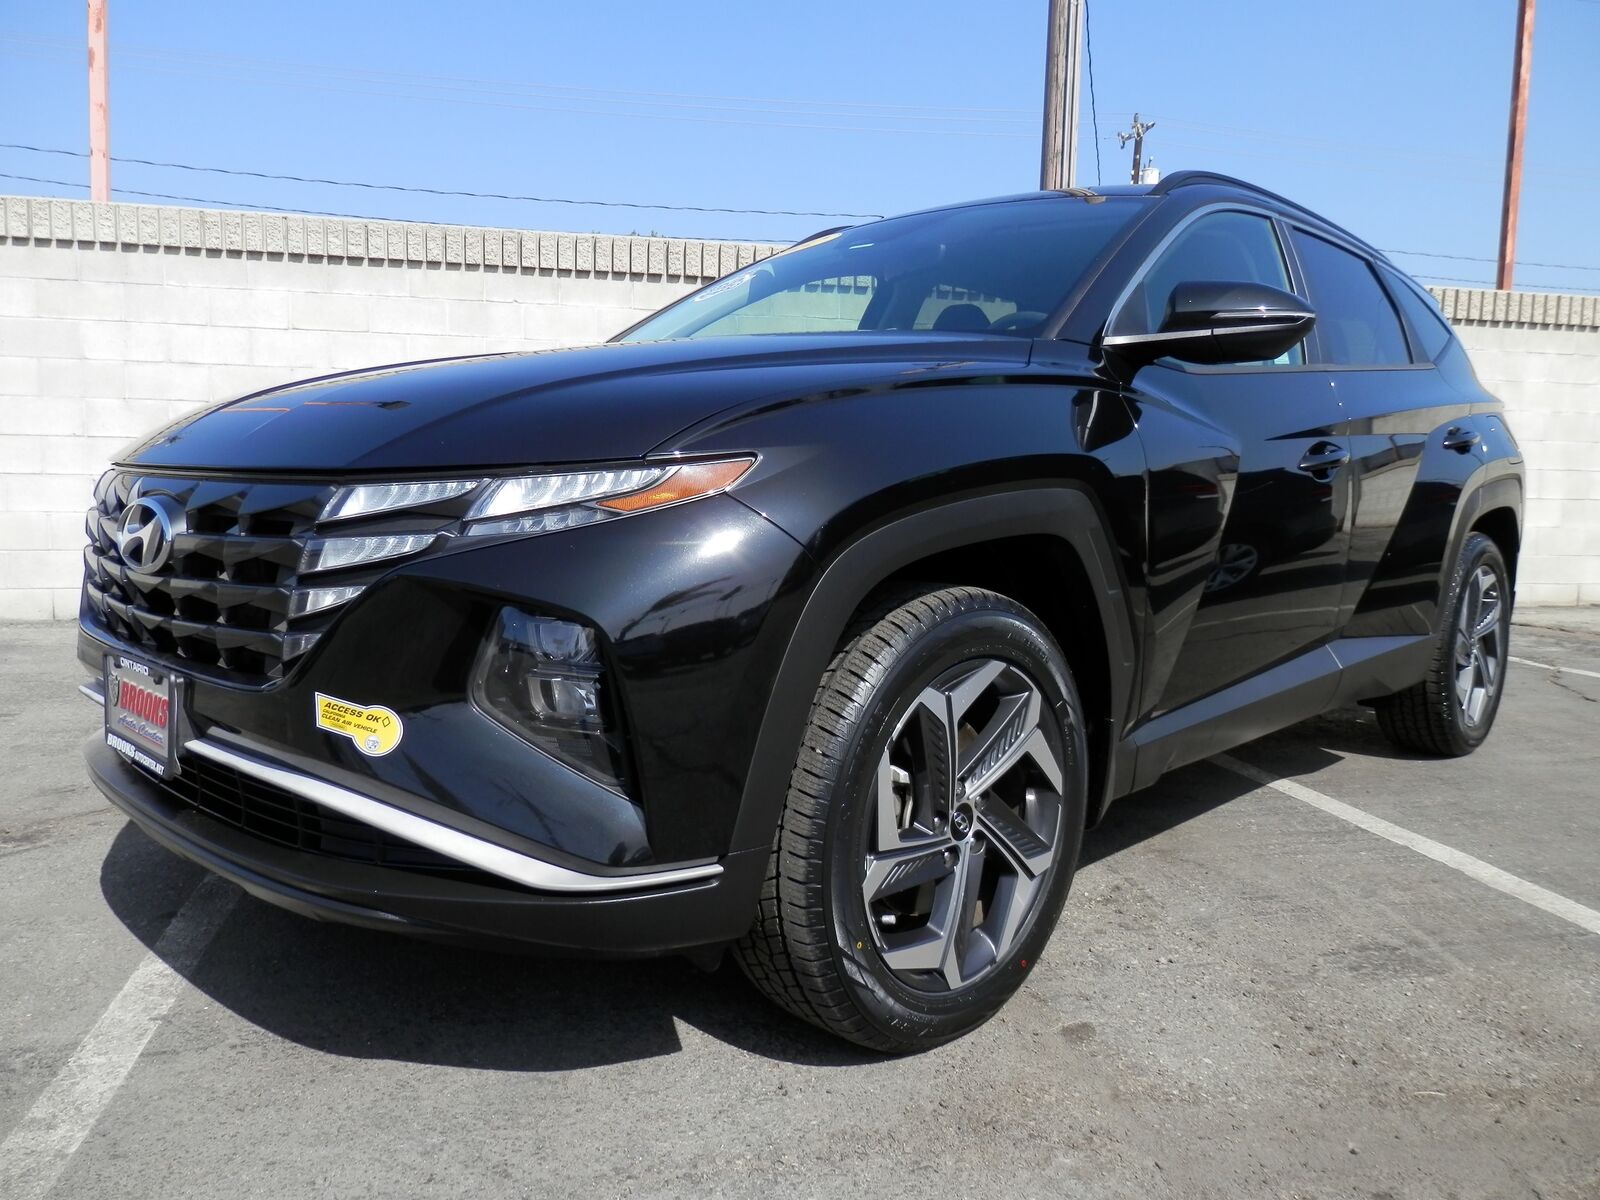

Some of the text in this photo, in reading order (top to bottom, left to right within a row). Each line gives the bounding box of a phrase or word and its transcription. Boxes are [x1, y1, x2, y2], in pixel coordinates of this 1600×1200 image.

[120, 657, 149, 676] ONTARIO
[120, 680, 169, 729] BROOKS
[324, 702, 382, 723] ACCESS OK
[321, 713, 341, 723] CLEAN
[353, 722, 379, 734] VEHICLE
[107, 733, 136, 758] BROOKS
